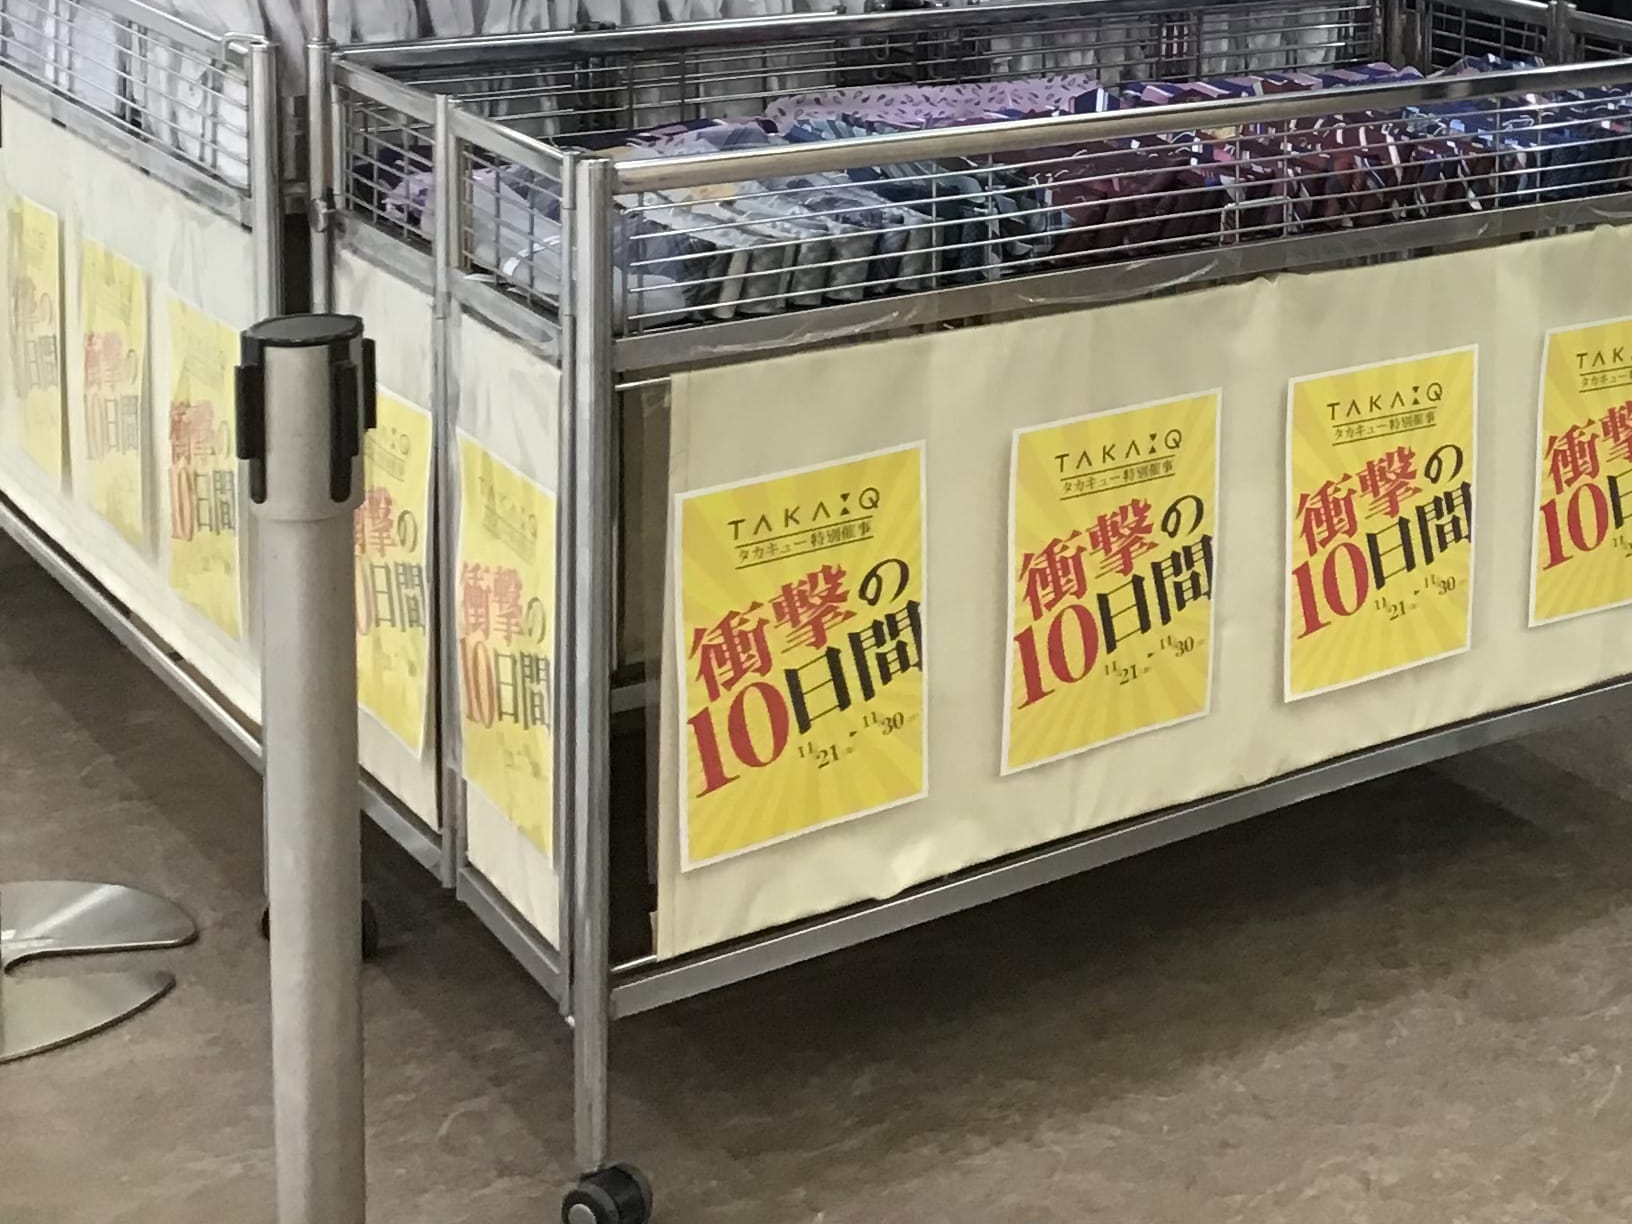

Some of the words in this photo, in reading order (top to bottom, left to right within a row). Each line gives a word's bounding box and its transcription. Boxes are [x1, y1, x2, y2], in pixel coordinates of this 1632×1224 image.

[1018, 493, 1205, 622] 衝撃の
[1292, 480, 1473, 640] 10日間
[1296, 443, 1464, 558] 衝撃の
[688, 557, 911, 703] 衝撃の
[1013, 533, 1213, 711] 10日間
[686, 599, 923, 800] 10日間
